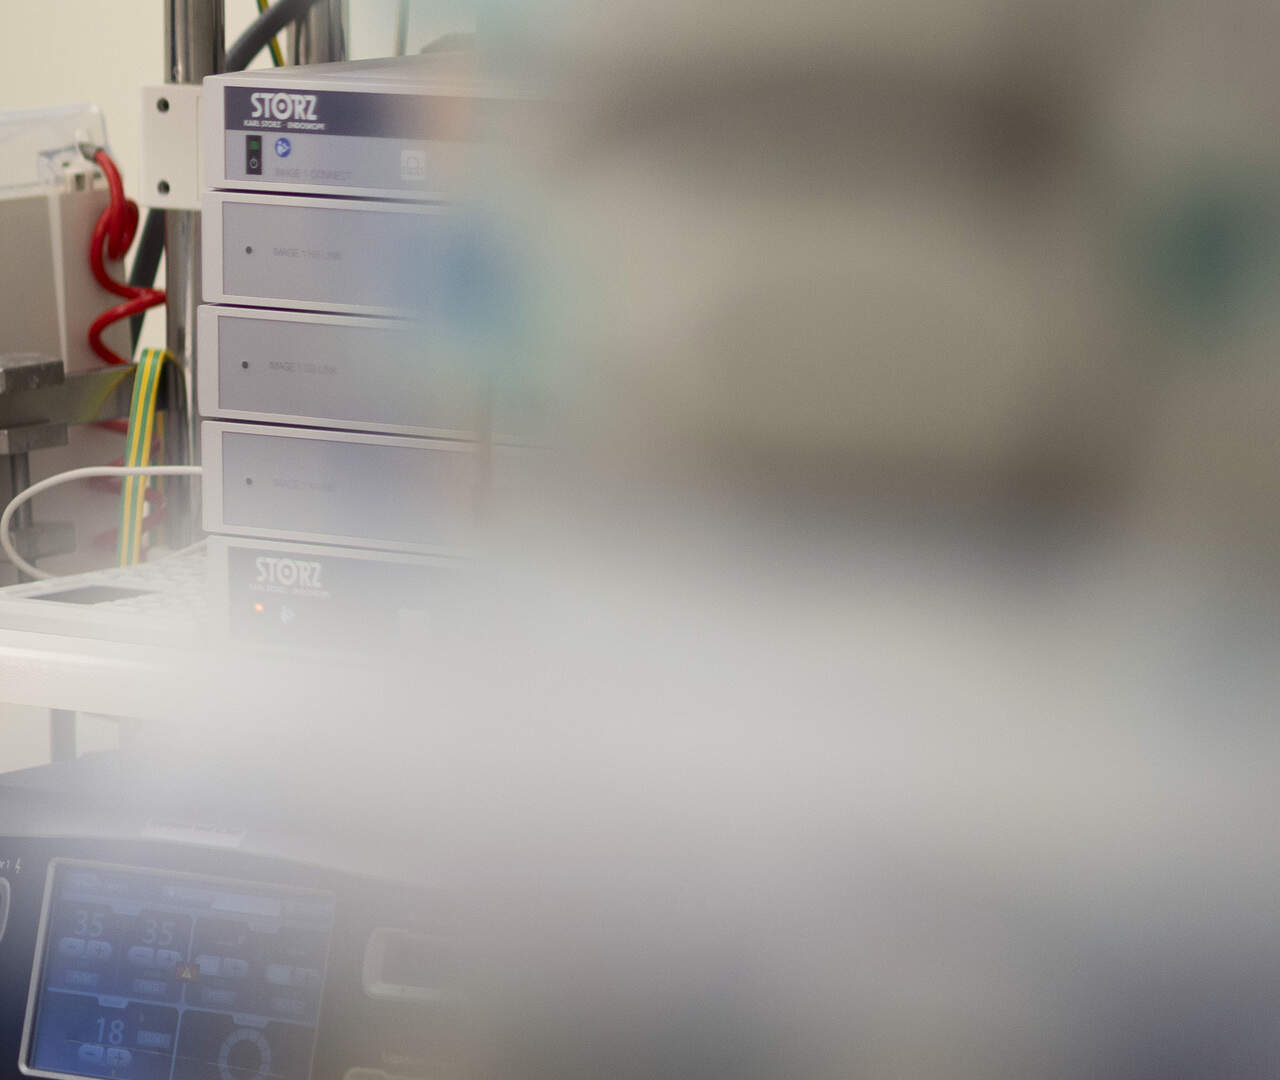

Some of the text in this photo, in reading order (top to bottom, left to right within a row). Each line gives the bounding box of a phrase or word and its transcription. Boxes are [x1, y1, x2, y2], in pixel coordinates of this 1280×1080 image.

[251, 93, 319, 121] STORZ
[256, 557, 323, 588] STORZ
[73, 909, 104, 938] 35
[140, 918, 176, 947] 35
[96, 1016, 125, 1045] 18
